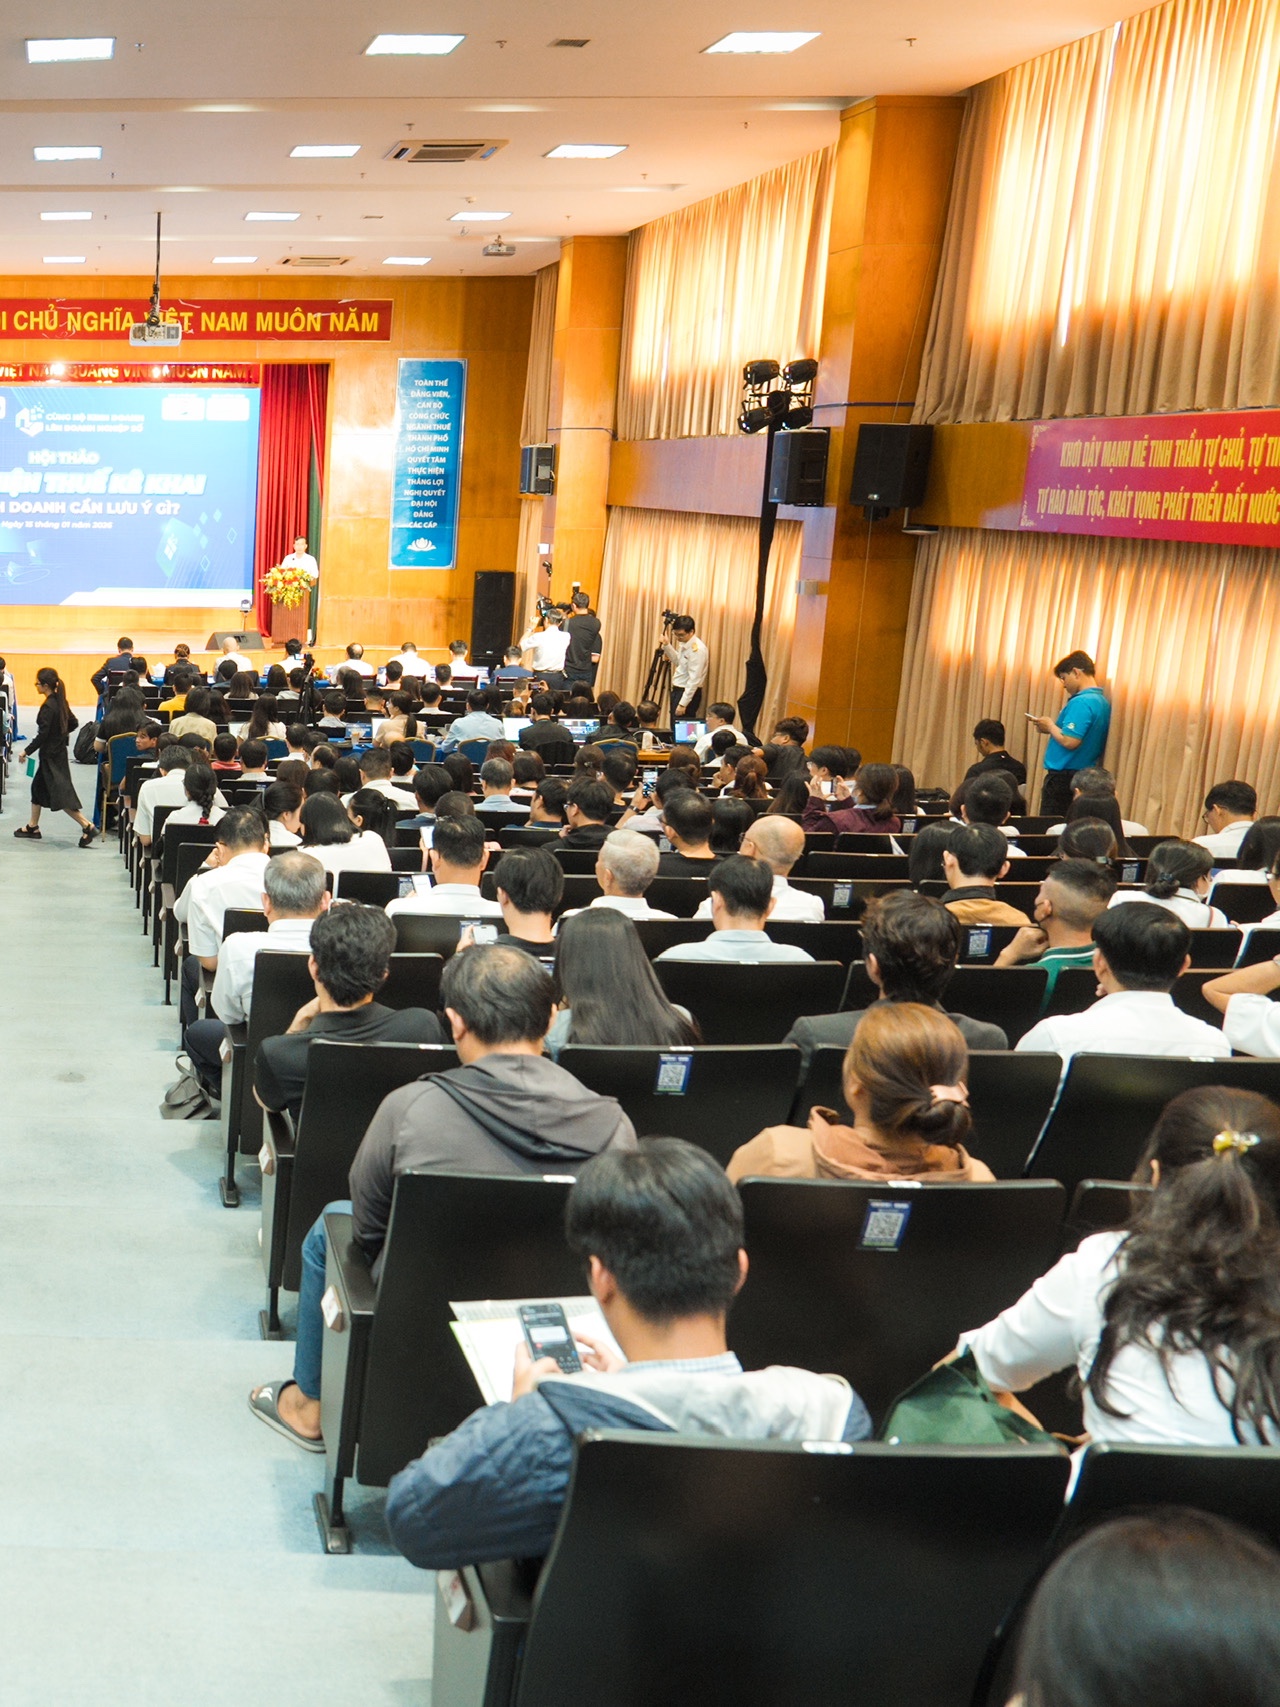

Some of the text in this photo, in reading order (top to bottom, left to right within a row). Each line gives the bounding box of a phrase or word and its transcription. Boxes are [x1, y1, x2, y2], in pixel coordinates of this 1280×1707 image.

[13, 303, 58, 331] CHỦ
[67, 307, 134, 332] NGHĨA
[201, 311, 247, 332] NAM
[256, 306, 321, 332] MUÔN
[329, 306, 379, 332] NĂM
[69, 365, 119, 378] QUANG
[414, 378, 434, 386] TOÀN
[432, 390, 450, 399] VIÊN,
[430, 411, 450, 419] CHỨC
[433, 422, 451, 430] THUẾ
[433, 433, 448, 441] PHỐ
[1060, 439, 1083, 467] KHƠI
[1081, 435, 1102, 473] DẬY
[1100, 440, 1132, 474] MẠNH
[1130, 434, 1149, 467] MẼ
[1148, 439, 1174, 467] TINH
[1173, 428, 1204, 467] THẦN
[1203, 434, 1222, 475] TỰ
[1219, 426, 1245, 471] CHỦ,
[1248, 432, 1268, 475] TỰ
[28, 448, 100, 466] HỘI THẢO
[407, 456, 429, 464] QUYẾT
[408, 466, 445, 475] THỰC HIỆN
[43, 466, 113, 494] THUẾ
[108, 468, 144, 494] KÊ
[144, 473, 207, 495] KHAI
[404, 488, 446, 497] NGHỊ QUYẾT
[9, 501, 66, 513] DOANH
[70, 498, 103, 514] CẦN
[106, 501, 138, 515] LƯU
[141, 500, 153, 515] Ý
[155, 500, 181, 515] GÌ?
[424, 500, 437, 508] HỘI
[1036, 486, 1050, 519] TỰ
[1047, 483, 1067, 515] HÀO
[1066, 484, 1087, 516] DÂN
[1086, 484, 1106, 522] TỘC,
[1106, 484, 1134, 518] KHÁT
[1133, 490, 1161, 525] VỌNG
[1160, 485, 1191, 521] PHÁT
[1190, 480, 1224, 522] TRIỂN
[1222, 482, 1249, 523] ĐẤT
[413, 510, 433, 518] ĐẢNG
[1, 520, 24, 529] Ngày
[25, 520, 34, 528] 15
[34, 520, 60, 530] tháng
[92, 521, 113, 529] 2026
